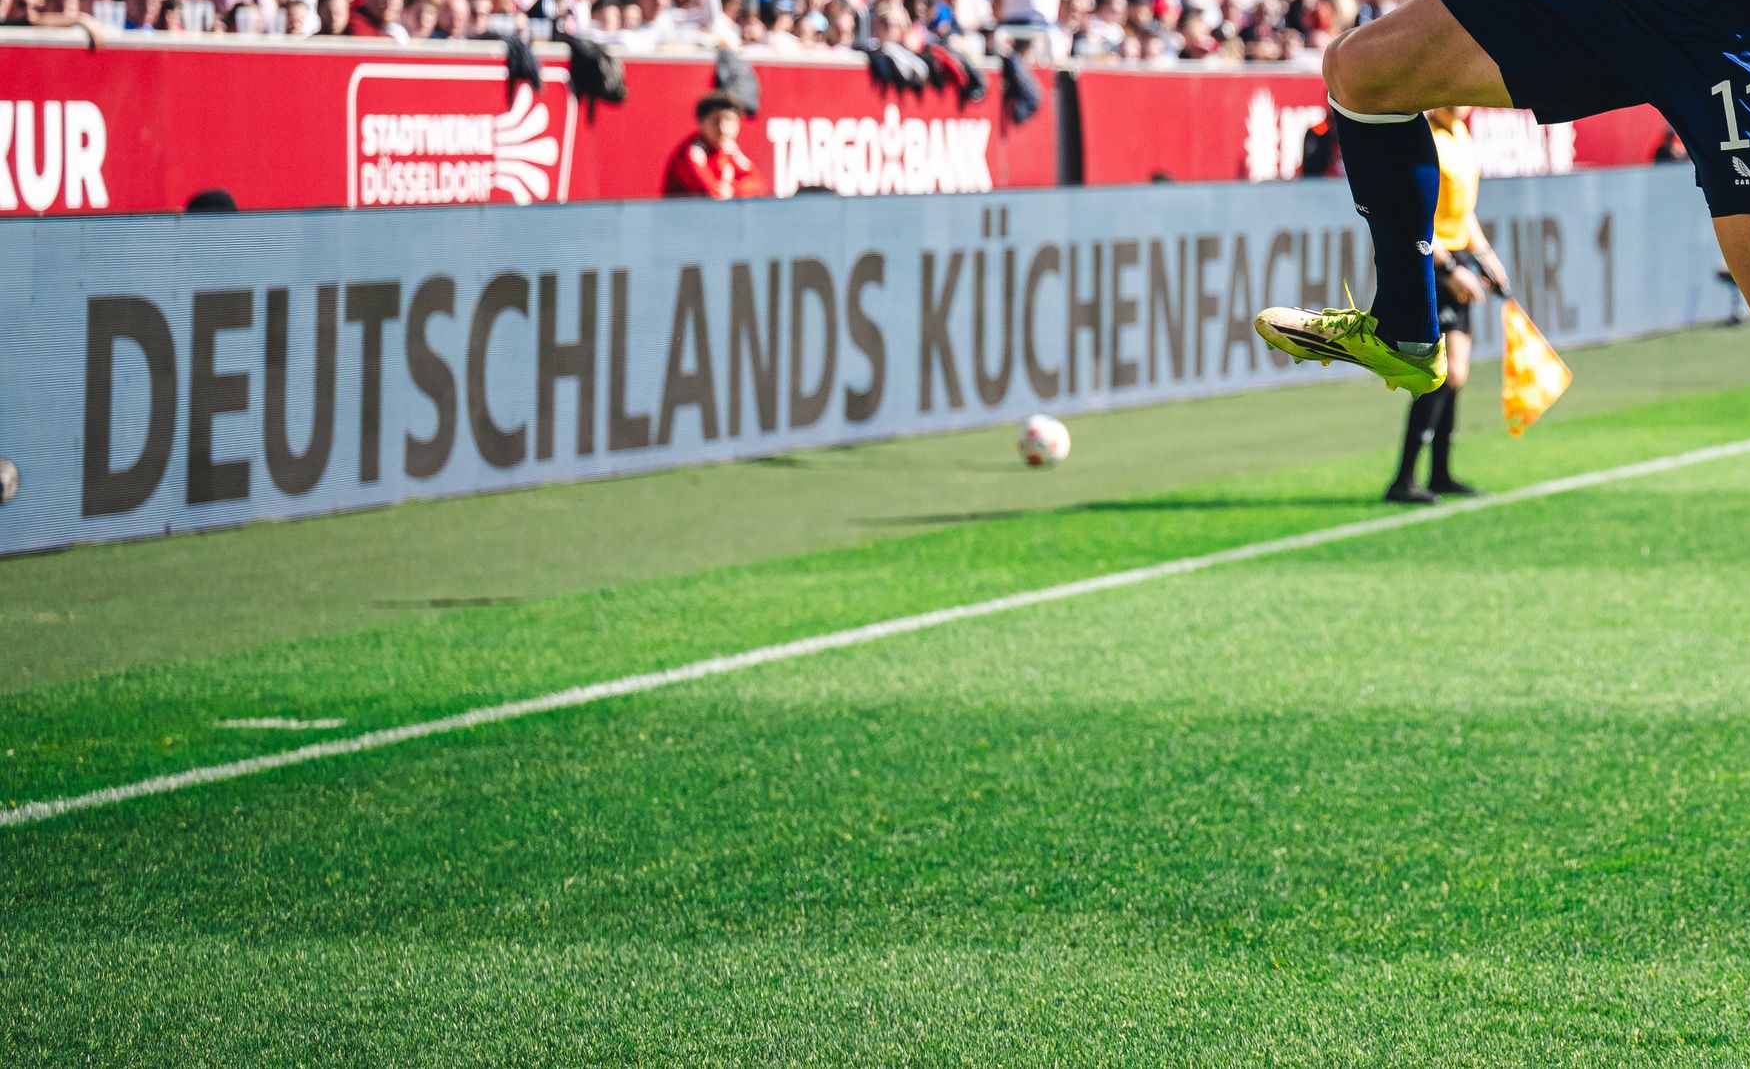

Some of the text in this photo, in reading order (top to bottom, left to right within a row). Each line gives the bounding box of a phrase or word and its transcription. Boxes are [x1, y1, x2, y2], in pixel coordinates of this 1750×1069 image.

[361, 113, 494, 156] STADTWERKE
[361, 154, 492, 205] DÜSSELDORF
[81, 252, 887, 518] DEUTSCHLANDS
[1595, 210, 1614, 328] 1
